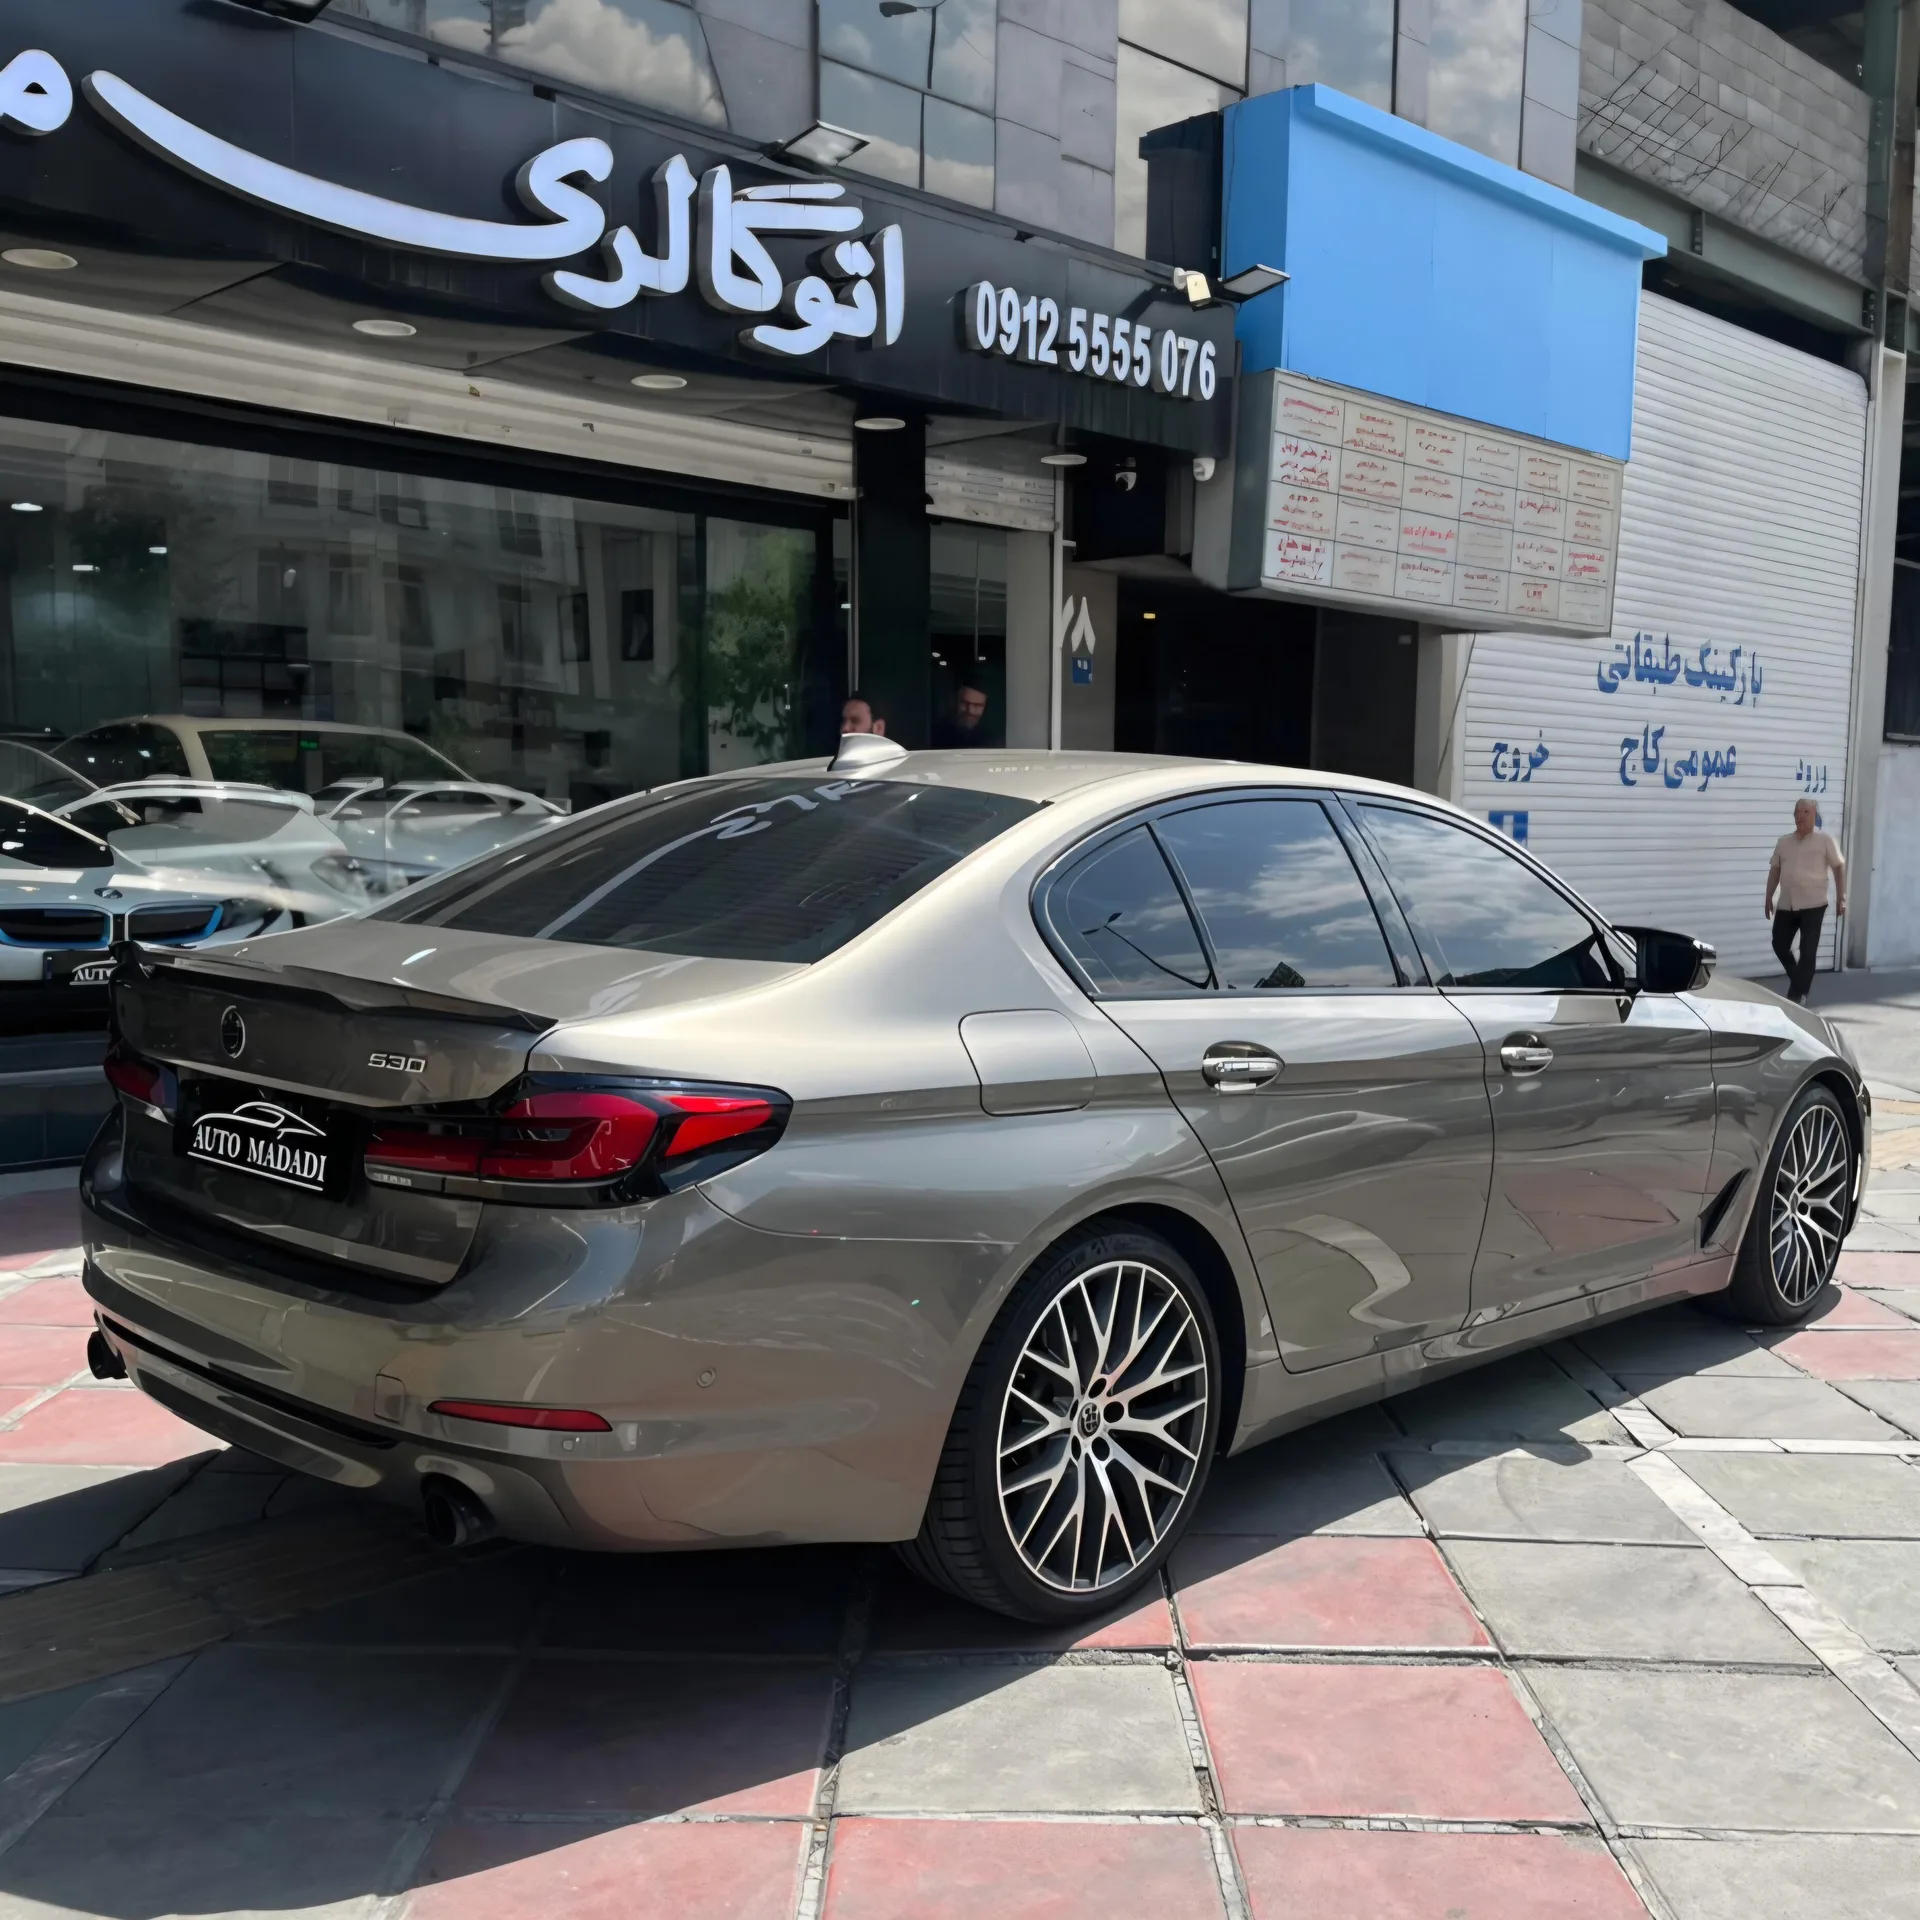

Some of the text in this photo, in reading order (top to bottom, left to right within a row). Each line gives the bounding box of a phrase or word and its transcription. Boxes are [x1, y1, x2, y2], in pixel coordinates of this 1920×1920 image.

[975, 280, 1218, 400] 0912 5555 076
[1596, 629, 1682, 694] طبقاتی
[1491, 729, 1550, 783] خروج
[1619, 721, 1738, 792] عمومی کاج
[367, 1052, 427, 1074] 530
[192, 1123, 328, 1183] AUTO MADADI
